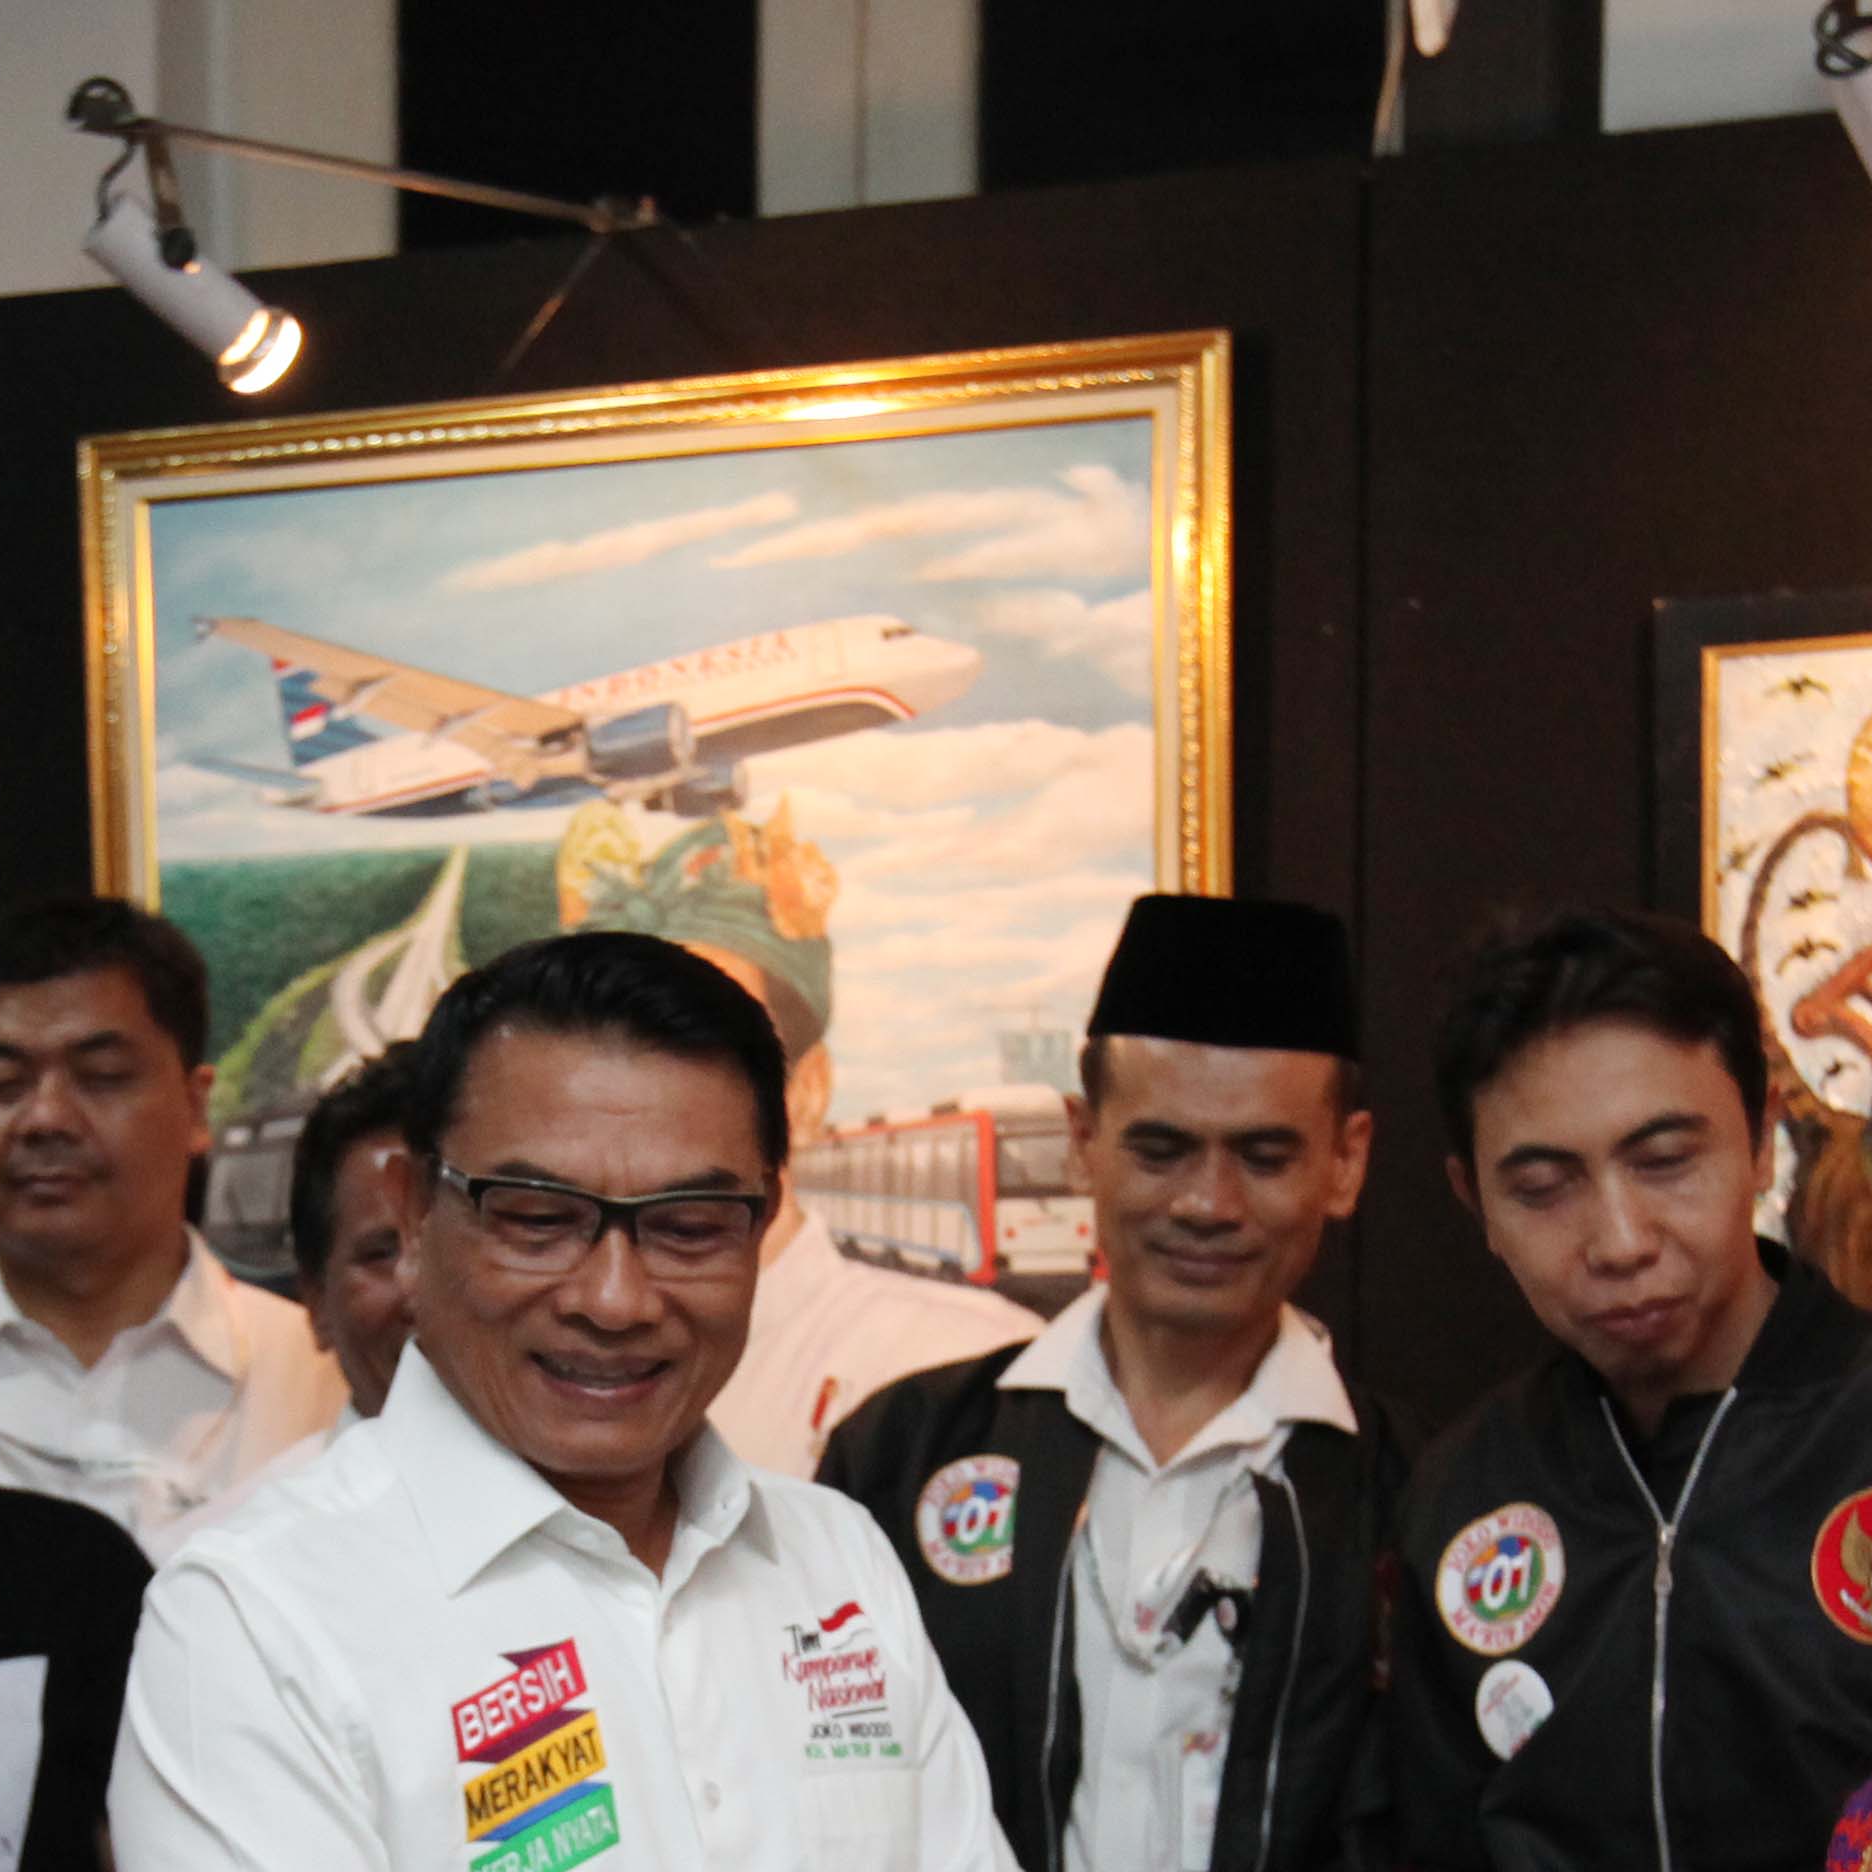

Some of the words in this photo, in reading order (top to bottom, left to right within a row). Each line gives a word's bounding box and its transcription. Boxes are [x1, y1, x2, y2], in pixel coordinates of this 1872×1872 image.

[957, 1495, 1012, 1545] 01
[1482, 1545, 1534, 1611] 01
[456, 1652, 577, 1752] BERSIH
[464, 1727, 600, 1829] MERAKYAT
[551, 1804, 616, 1866] NYATA
